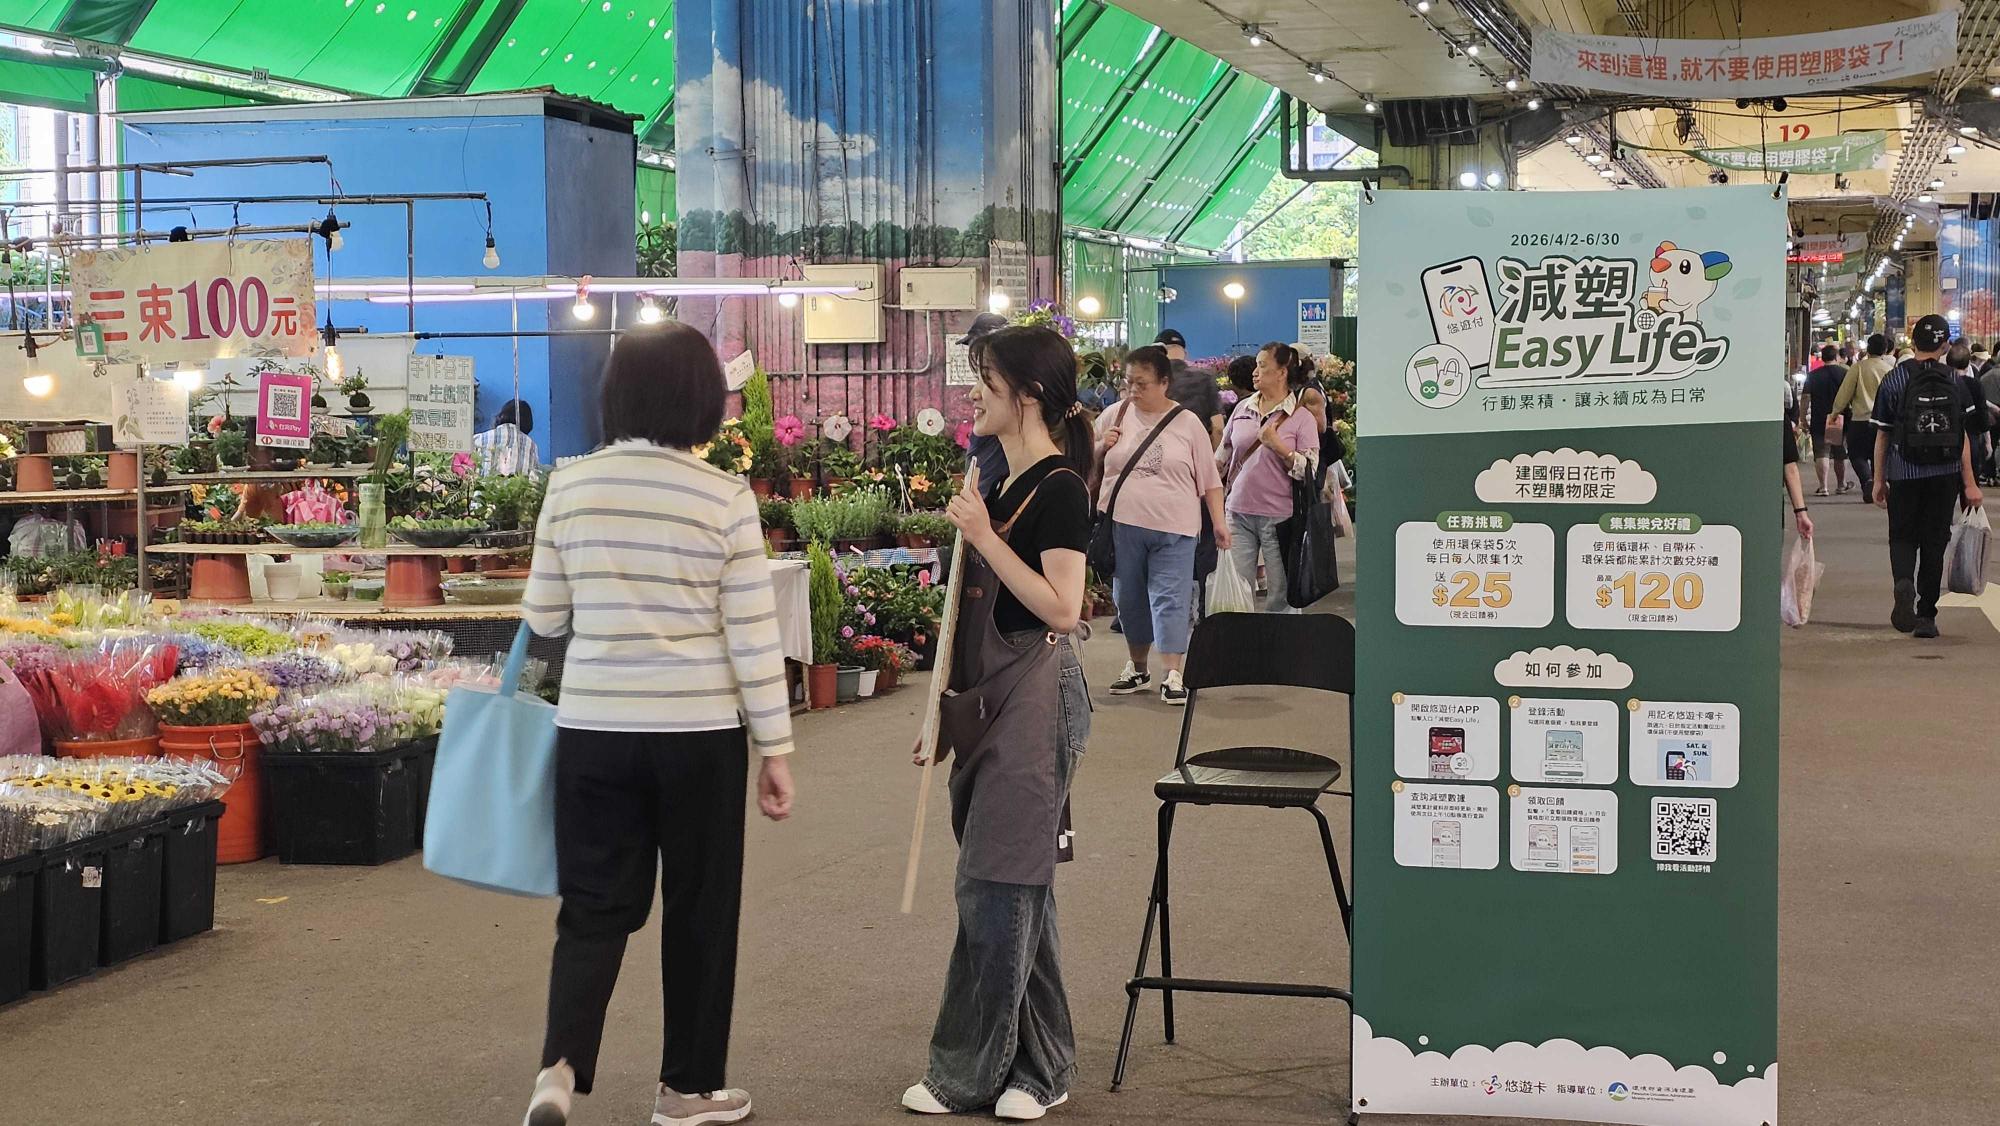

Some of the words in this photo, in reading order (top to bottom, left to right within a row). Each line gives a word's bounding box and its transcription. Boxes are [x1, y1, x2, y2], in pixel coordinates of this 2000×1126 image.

[1510, 233, 1621, 247] 2026/4/2-6/30
[1502, 263, 1628, 324] 減塑
[1494, 323, 1606, 378] Easy
[1609, 316, 1698, 376] Life
[1514, 465, 1616, 482] 建國假日花市
[1514, 482, 1616, 499] 不塑購物限定
[1446, 515, 1504, 530] 任務挑戰
[1609, 516, 1692, 532] 集集樂兌好禮
[1432, 538, 1517, 552] 使用環保袋5次
[1426, 552, 1523, 566] 每日每人限集1次
[1581, 553, 1719, 568] 環保袋都能累計次數兌好禮
[1431, 570, 1513, 609] $25
[1595, 571, 1704, 610] $120
[1525, 662, 1603, 680] 如何參加
[1528, 706, 1566, 717] 登錄活動
[1528, 796, 1565, 806] 領取回饋
[1504, 1080, 1547, 1094] 悠遊卡
